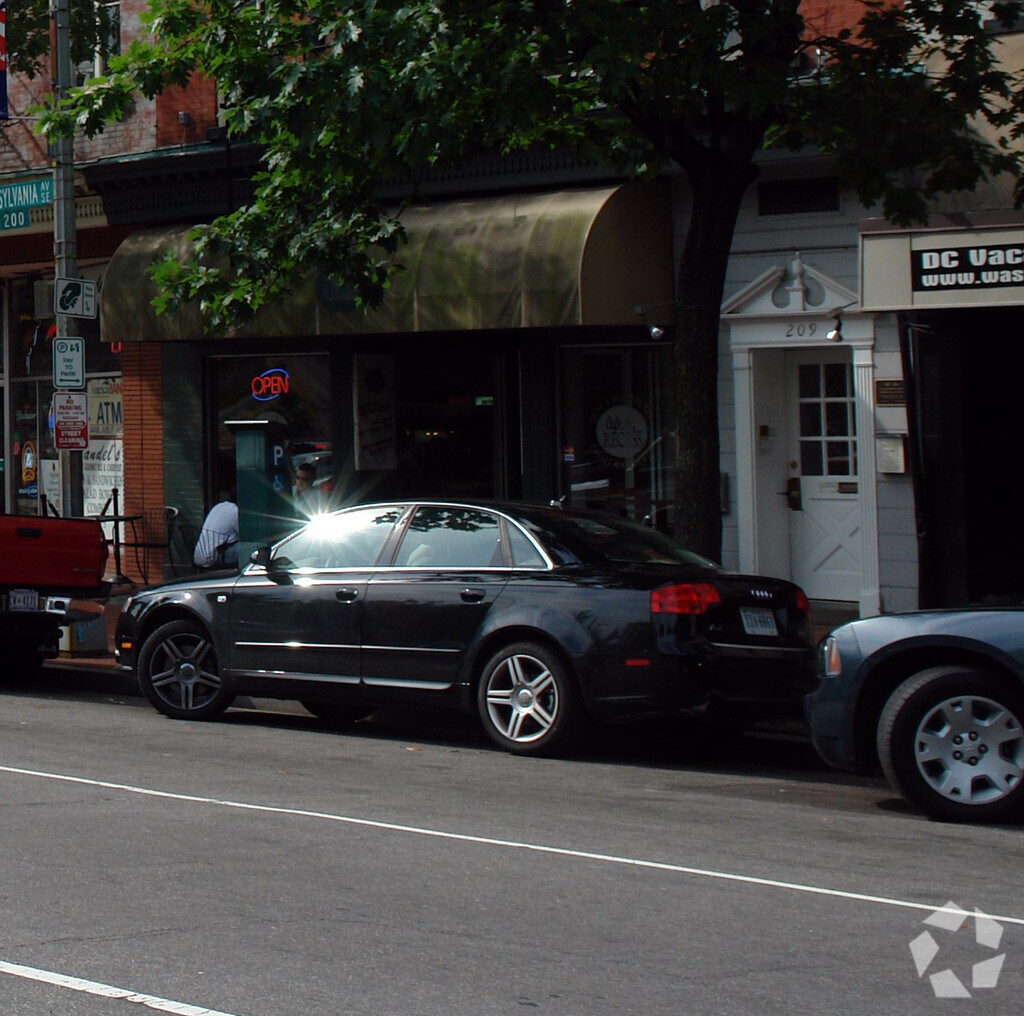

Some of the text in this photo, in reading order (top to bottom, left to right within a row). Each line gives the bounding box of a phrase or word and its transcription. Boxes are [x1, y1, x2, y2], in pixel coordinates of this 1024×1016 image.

[40, 181, 50, 192] AV
[40, 192, 50, 203] SE
[3, 212, 25, 228] 200
[922, 248, 1024, 270] DC Vac
[786, 323, 817, 338] 209
[251, 376, 289, 395] OPEN
[97, 401, 122, 425] ATM
[83, 443, 121, 461] andel's
[273, 445, 283, 466] P
